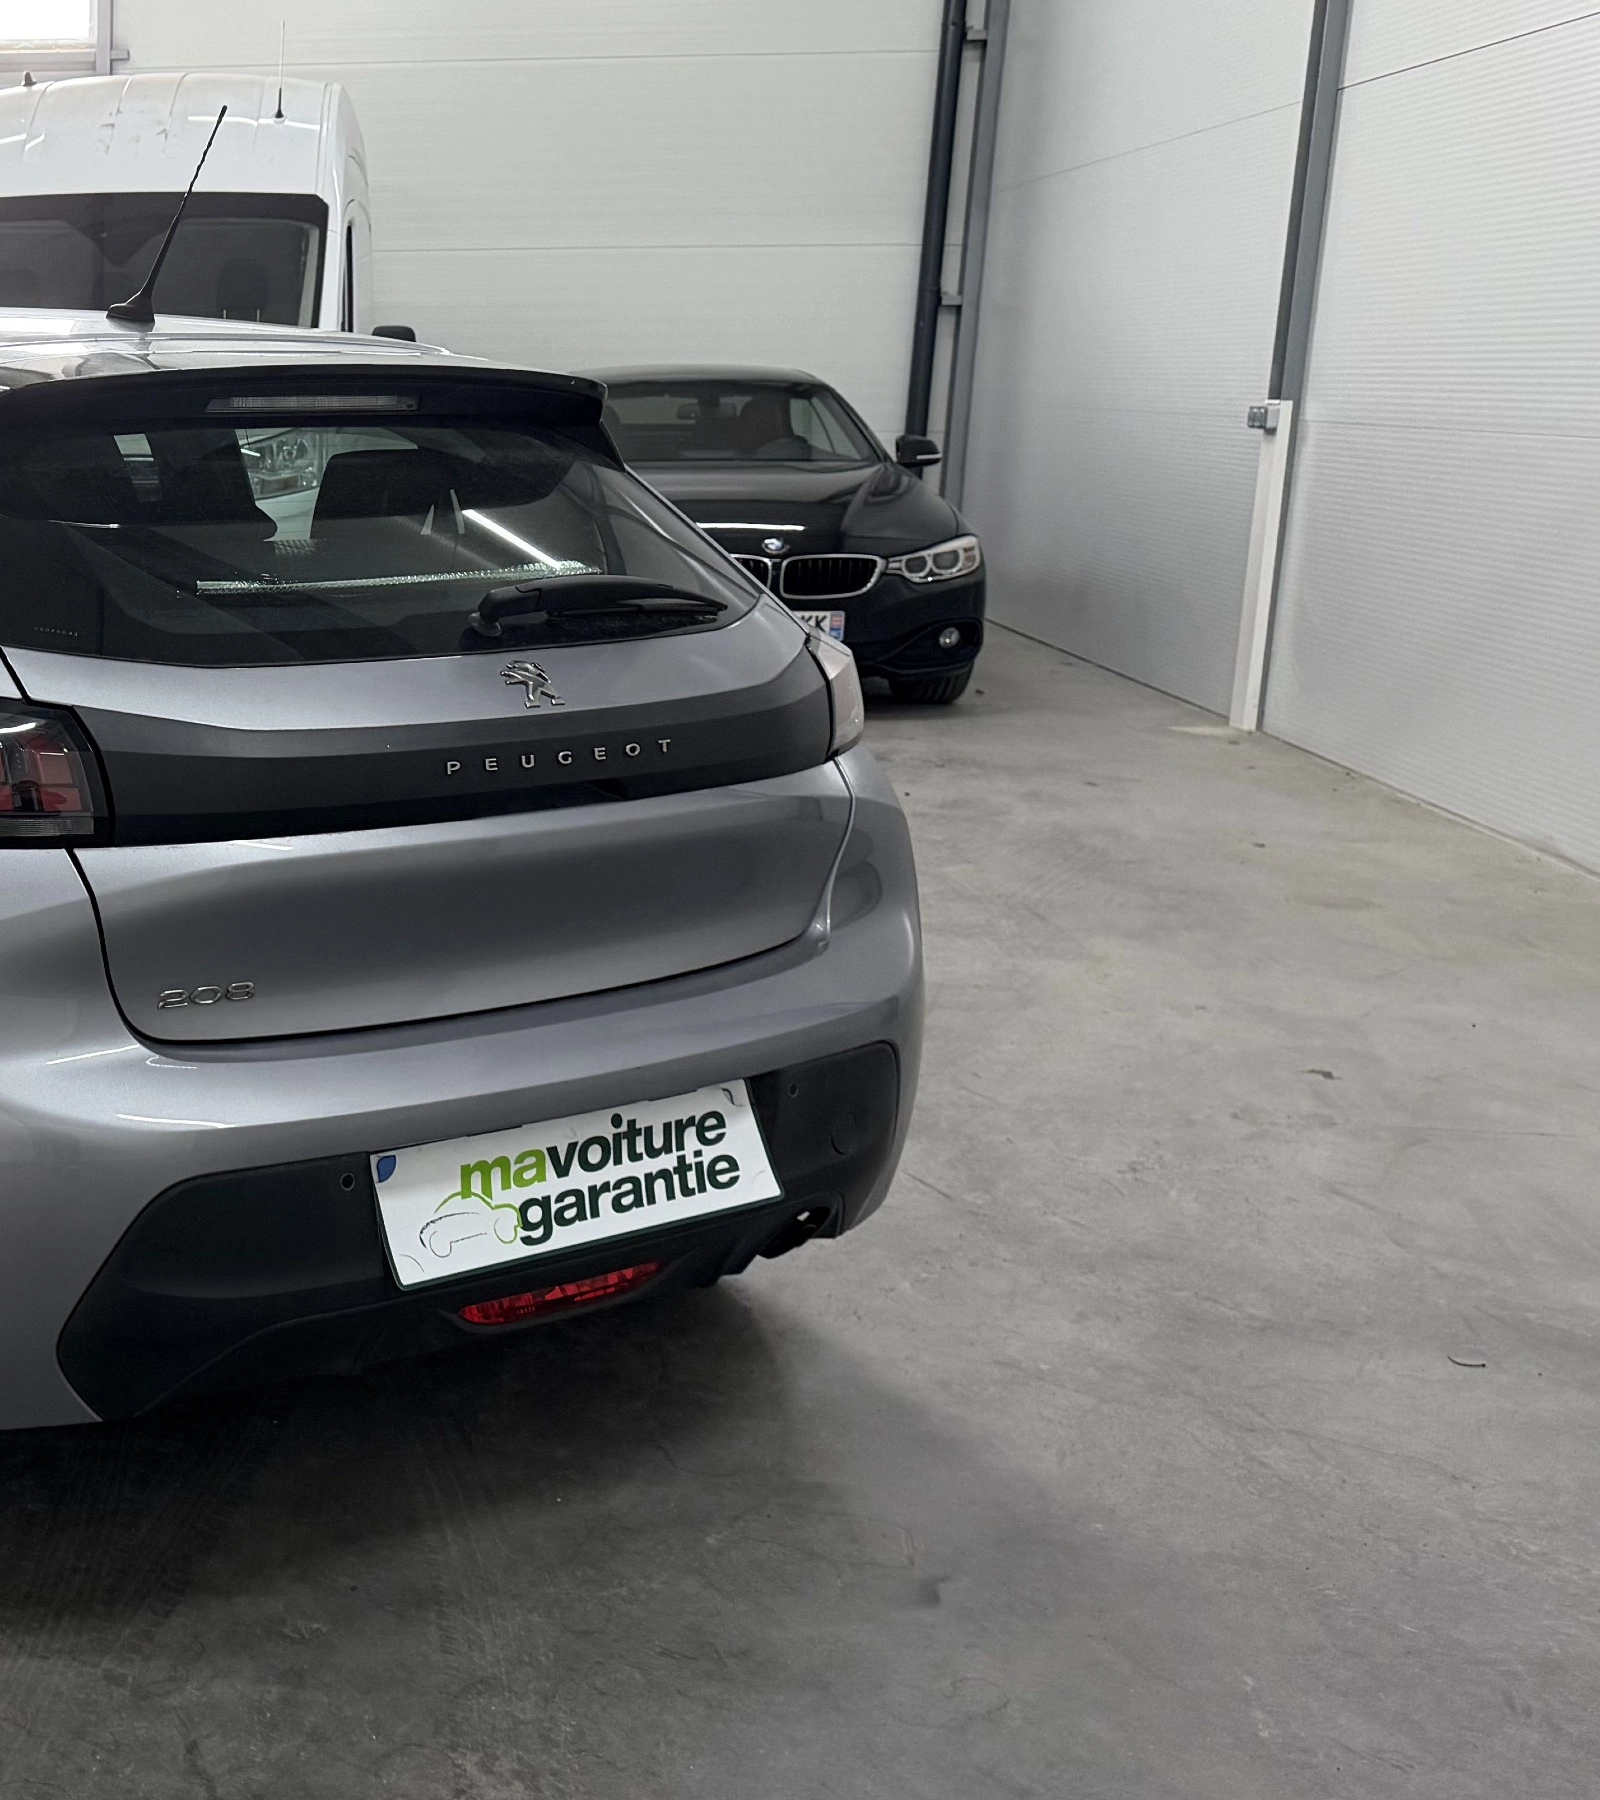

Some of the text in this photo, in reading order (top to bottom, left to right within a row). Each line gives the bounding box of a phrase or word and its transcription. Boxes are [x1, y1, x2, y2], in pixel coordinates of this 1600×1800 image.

[446, 739, 671, 775] PEUGEOT
[157, 981, 254, 1009] 208
[519, 1150, 740, 1246] garantie
